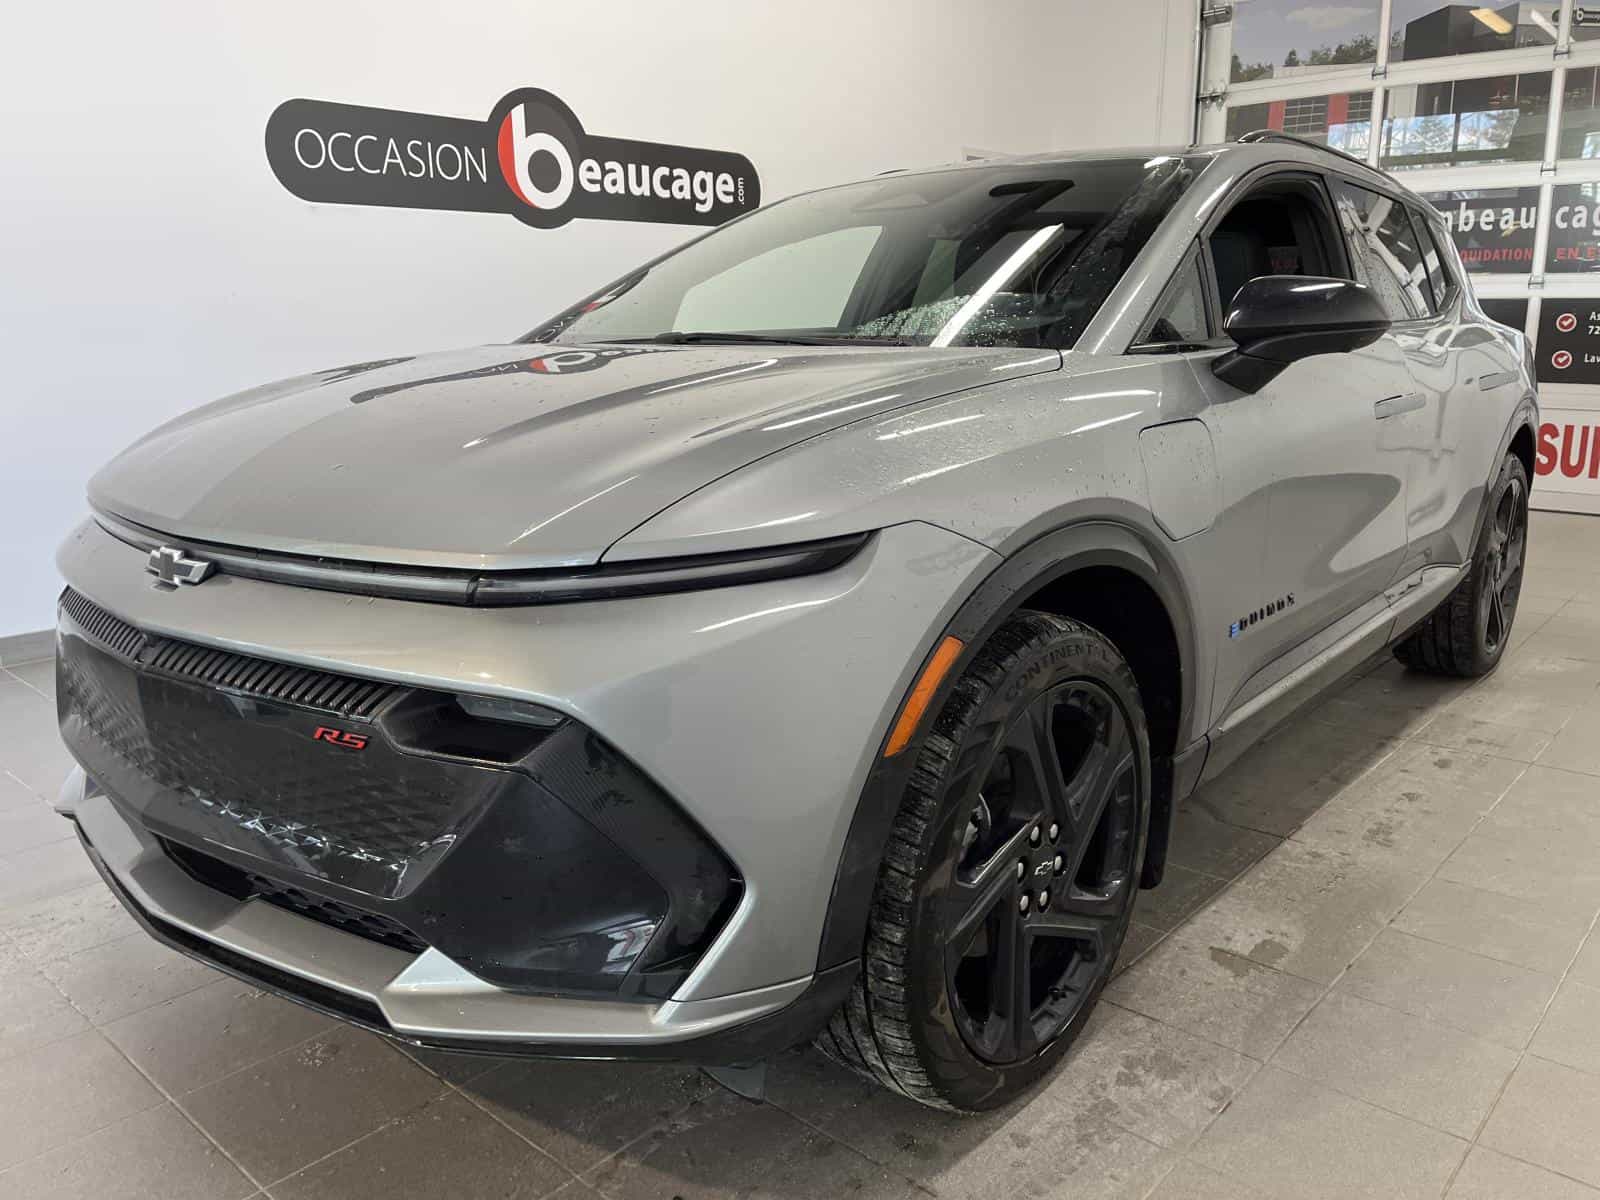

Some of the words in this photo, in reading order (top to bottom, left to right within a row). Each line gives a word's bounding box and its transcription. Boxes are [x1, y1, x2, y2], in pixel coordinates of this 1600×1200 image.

[294, 128, 487, 183] OCCASION
[1555, 247, 1580, 260] EN
[313, 726, 368, 750] RS
